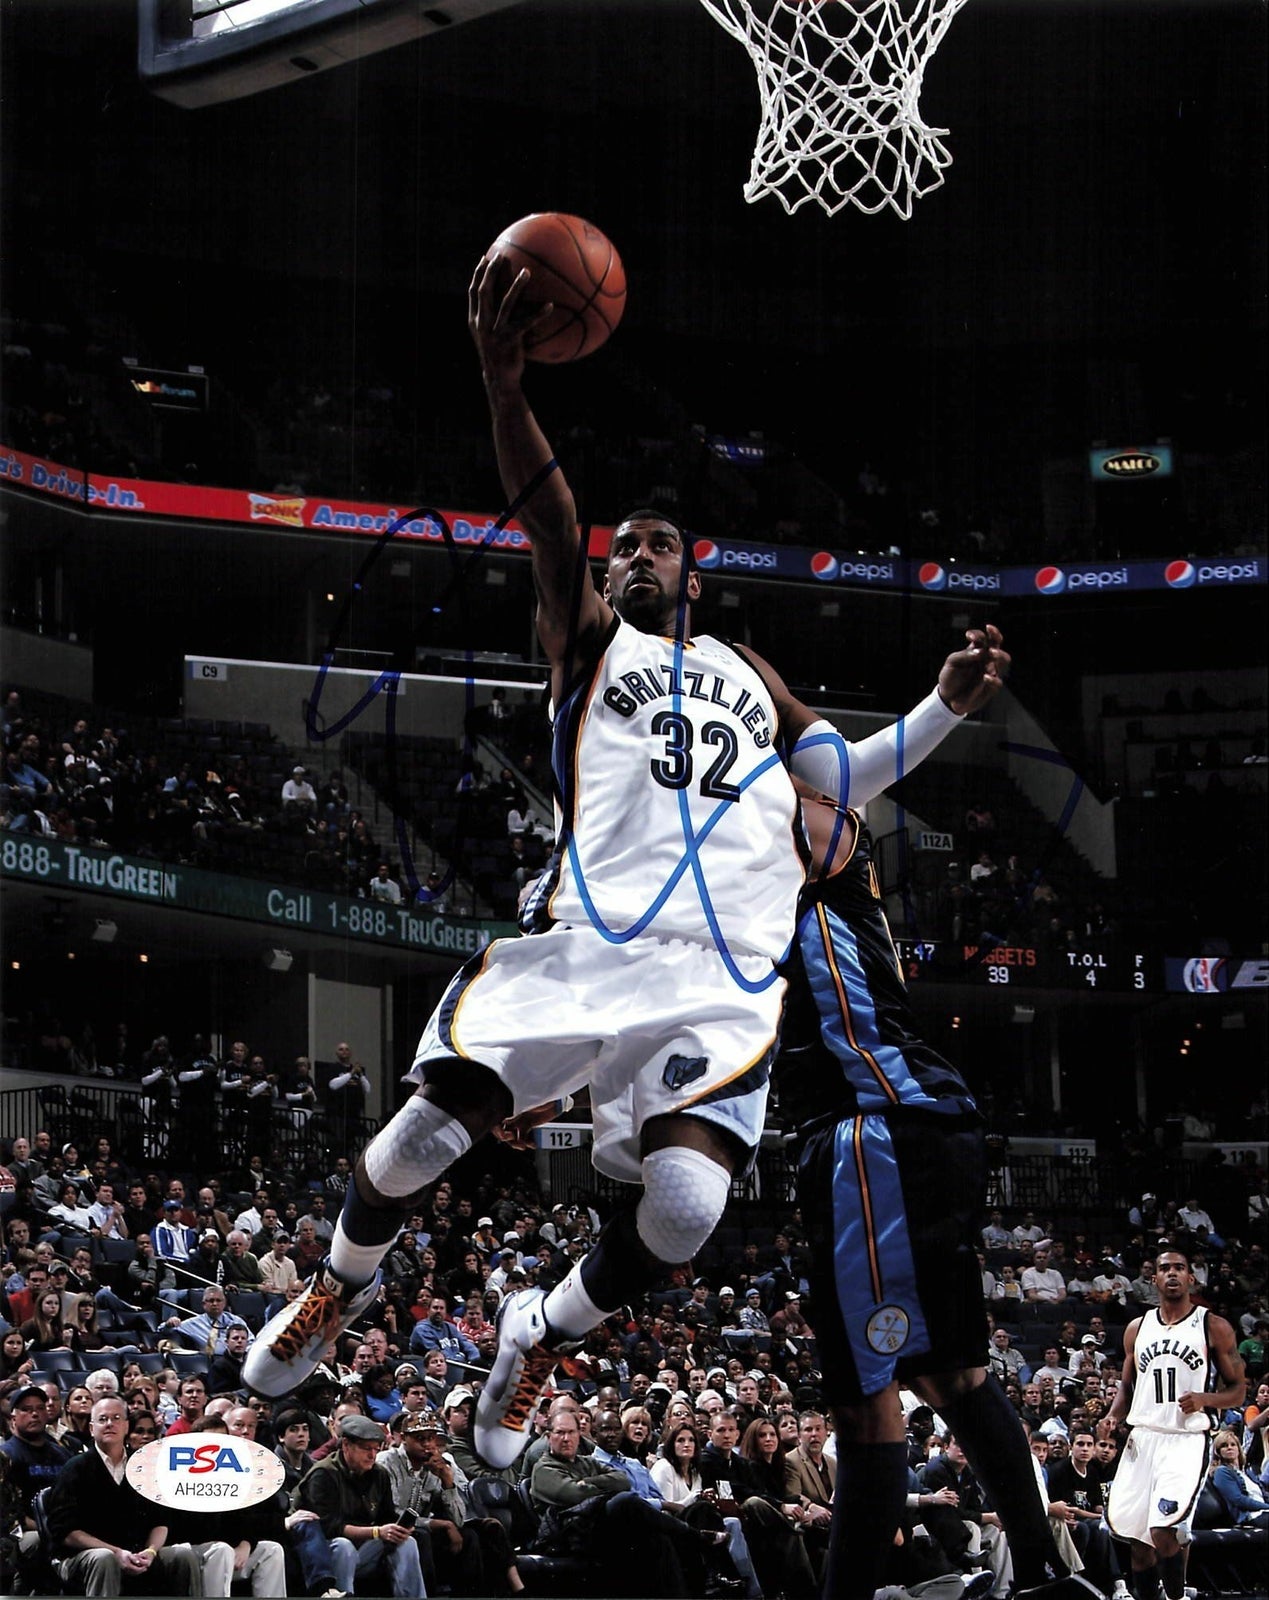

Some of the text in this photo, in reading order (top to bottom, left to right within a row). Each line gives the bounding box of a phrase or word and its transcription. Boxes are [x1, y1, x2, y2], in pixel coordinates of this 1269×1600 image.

[254, 503, 300, 518] SONIC
[453, 519, 529, 547] Drive
[722, 549, 777, 569] pepsi
[840, 561, 894, 580] pepsi
[1067, 568, 1128, 589] pepsi
[1198, 561, 1259, 583] pepsi
[948, 571, 1000, 590] pepsi
[202, 665, 218, 678] C9
[602, 664, 772, 751] GRIZZLIES
[650, 711, 741, 803] 32
[921, 833, 951, 849] 112A
[267, 889, 311, 923] Call
[963, 945, 1037, 967] NGGETS
[1135, 955, 1144, 968] F
[988, 966, 1009, 984] 39
[1086, 969, 1096, 987] 4
[1134, 972, 1145, 989] 3
[549, 1132, 573, 1146] 112
[1153, 1367, 1176, 1404] 11
